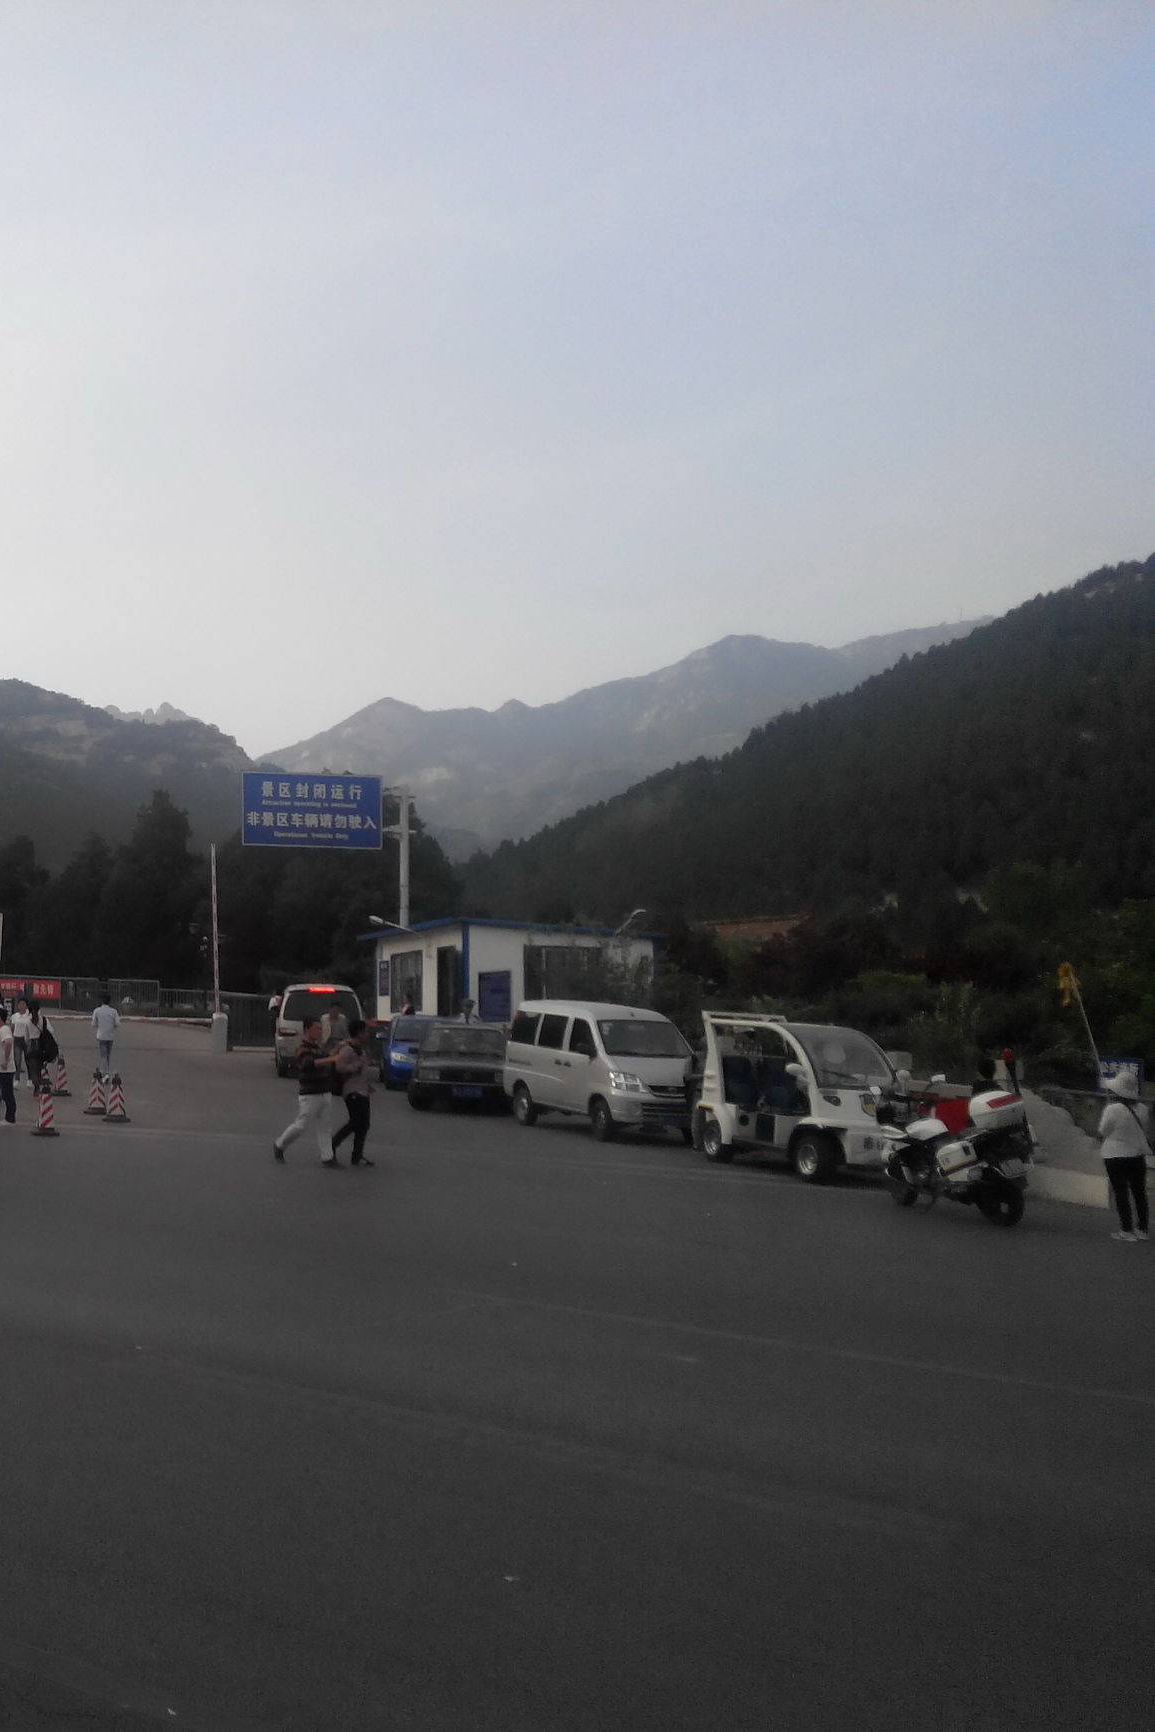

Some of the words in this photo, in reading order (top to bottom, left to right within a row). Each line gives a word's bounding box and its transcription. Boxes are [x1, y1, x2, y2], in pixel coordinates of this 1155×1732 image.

[262, 781, 363, 800] 景区封闭运行
[247, 811, 377, 830] 非景区车辆请勿驶入
